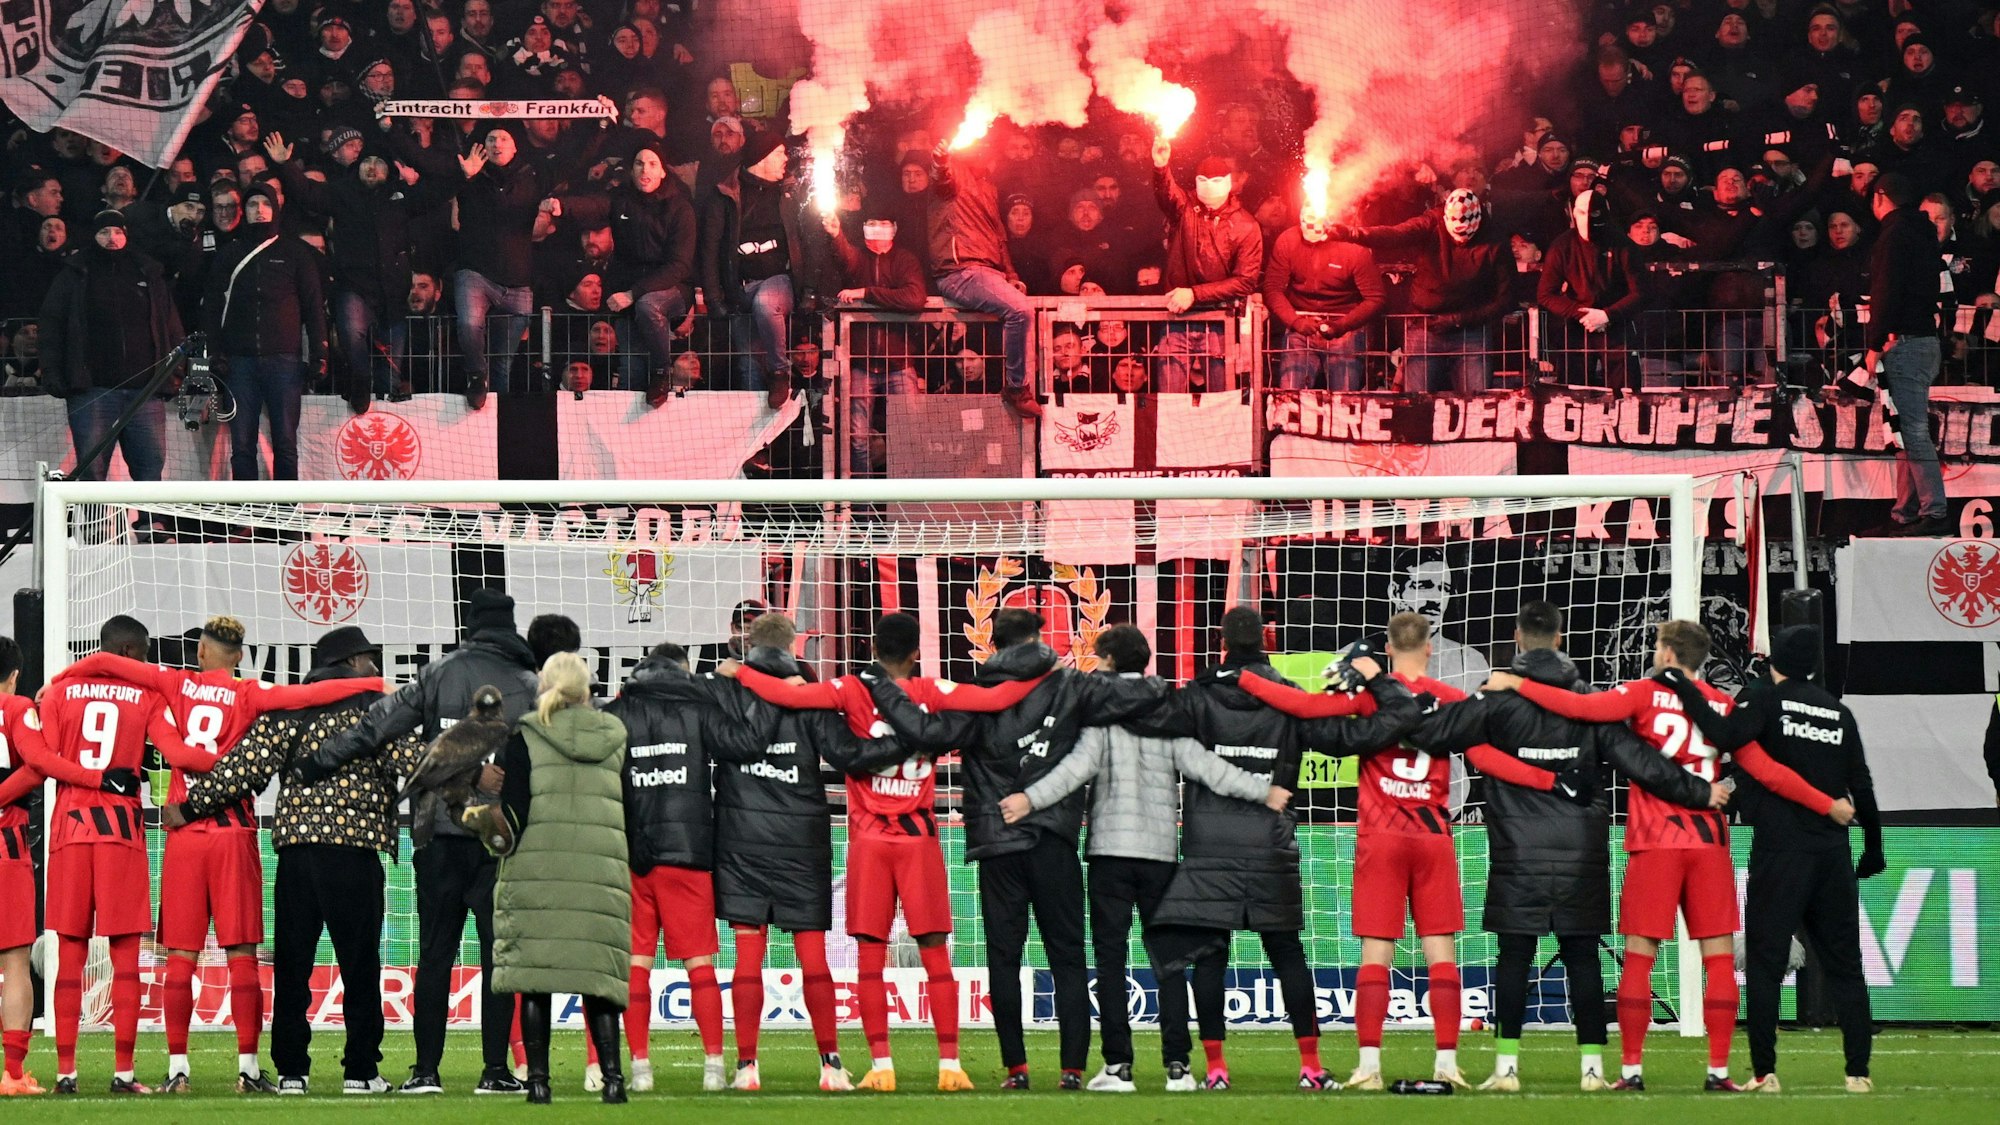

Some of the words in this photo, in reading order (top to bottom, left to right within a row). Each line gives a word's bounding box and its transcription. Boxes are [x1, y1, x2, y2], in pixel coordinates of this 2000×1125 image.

[383, 102, 472, 115] Eintracht
[1432, 397, 1534, 440] DER
[66, 683, 143, 704] FRANKFURT
[79, 701, 119, 769] 9
[1780, 715, 1843, 745] indeed
[1214, 744, 1279, 759] EINTRACHT
[631, 766, 687, 787] indeed
[1305, 759, 1342, 782] 317
